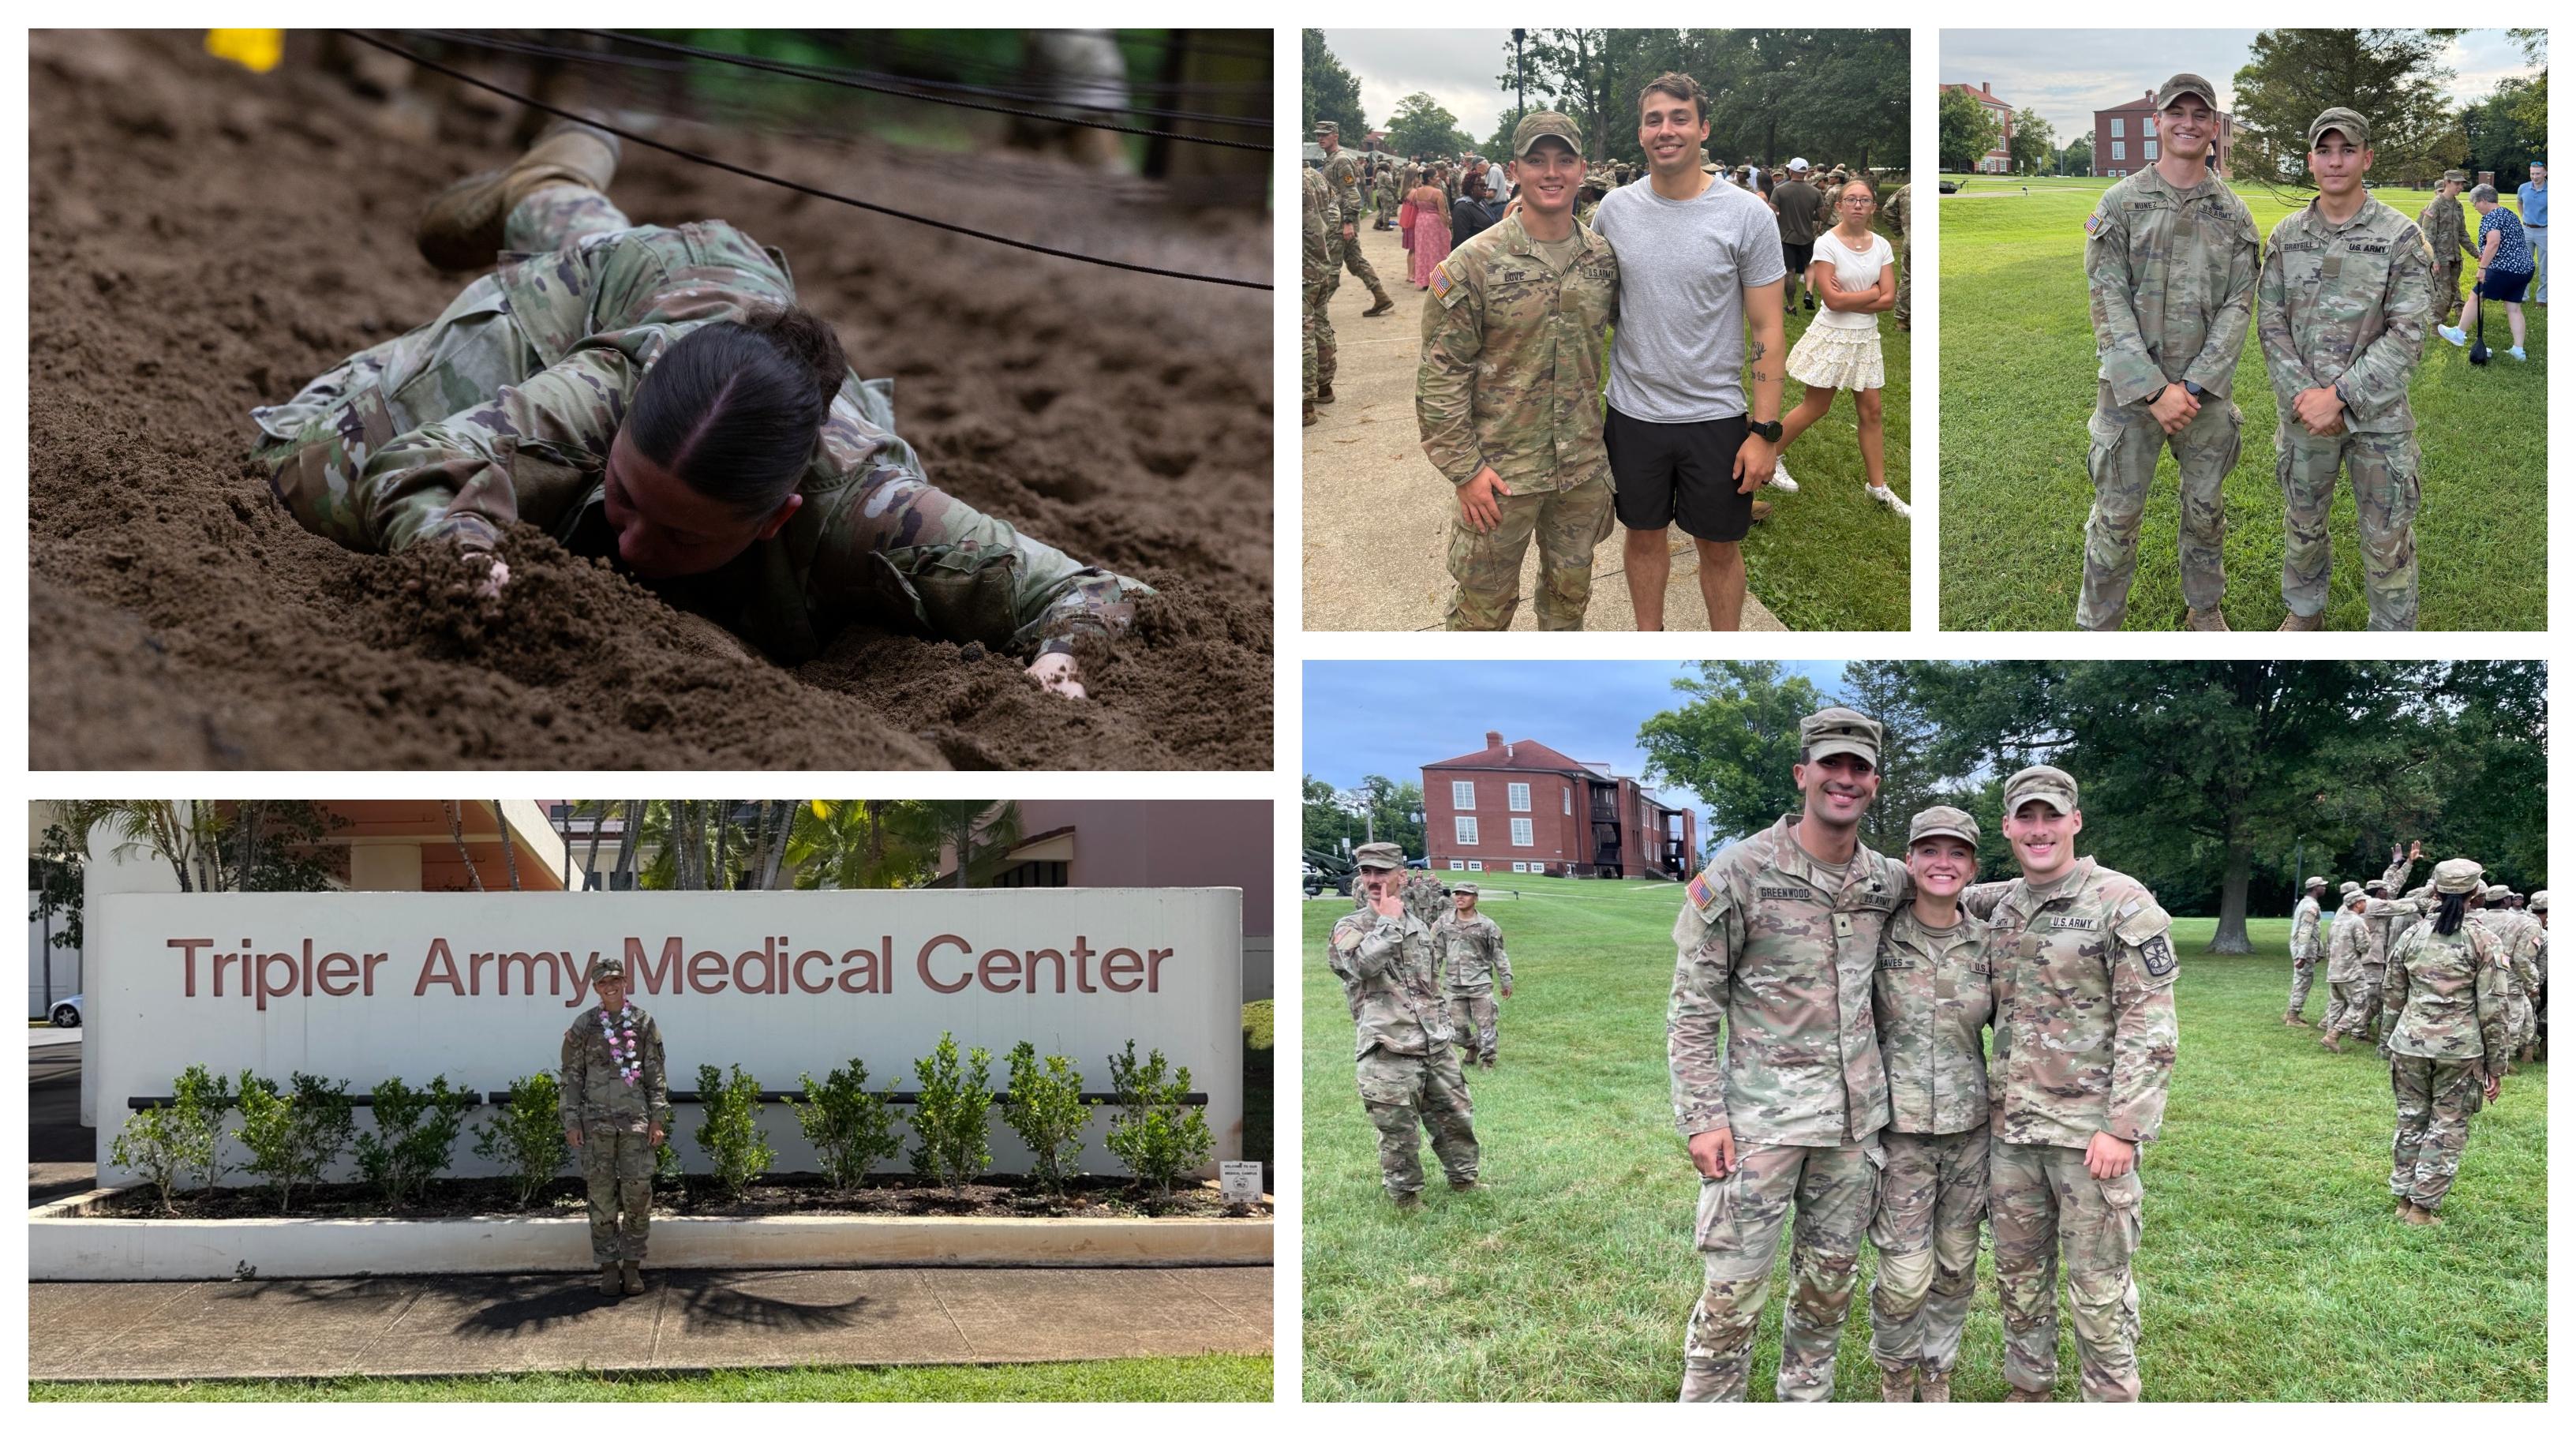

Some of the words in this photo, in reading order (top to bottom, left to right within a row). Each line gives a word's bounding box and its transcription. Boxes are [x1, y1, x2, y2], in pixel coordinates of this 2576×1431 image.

[2134, 201, 2157, 210] NUNEZ
[2214, 210, 2233, 220] ARMY
[2363, 245, 2386, 253] ARMY
[1503, 271, 1526, 283] LOVE
[1588, 268, 1598, 277] U.S.
[1598, 268, 1614, 279] ARMY
[1761, 887, 1810, 899] GREENWOOD
[1874, 897, 1891, 907] ARMY
[2054, 918, 2067, 927] U.S.
[2069, 918, 2093, 929] ARMY
[167, 938, 388, 1011] Tripler
[414, 938, 600, 1008] Army
[623, 936, 893, 995] Medical
[917, 934, 1174, 994] Center
